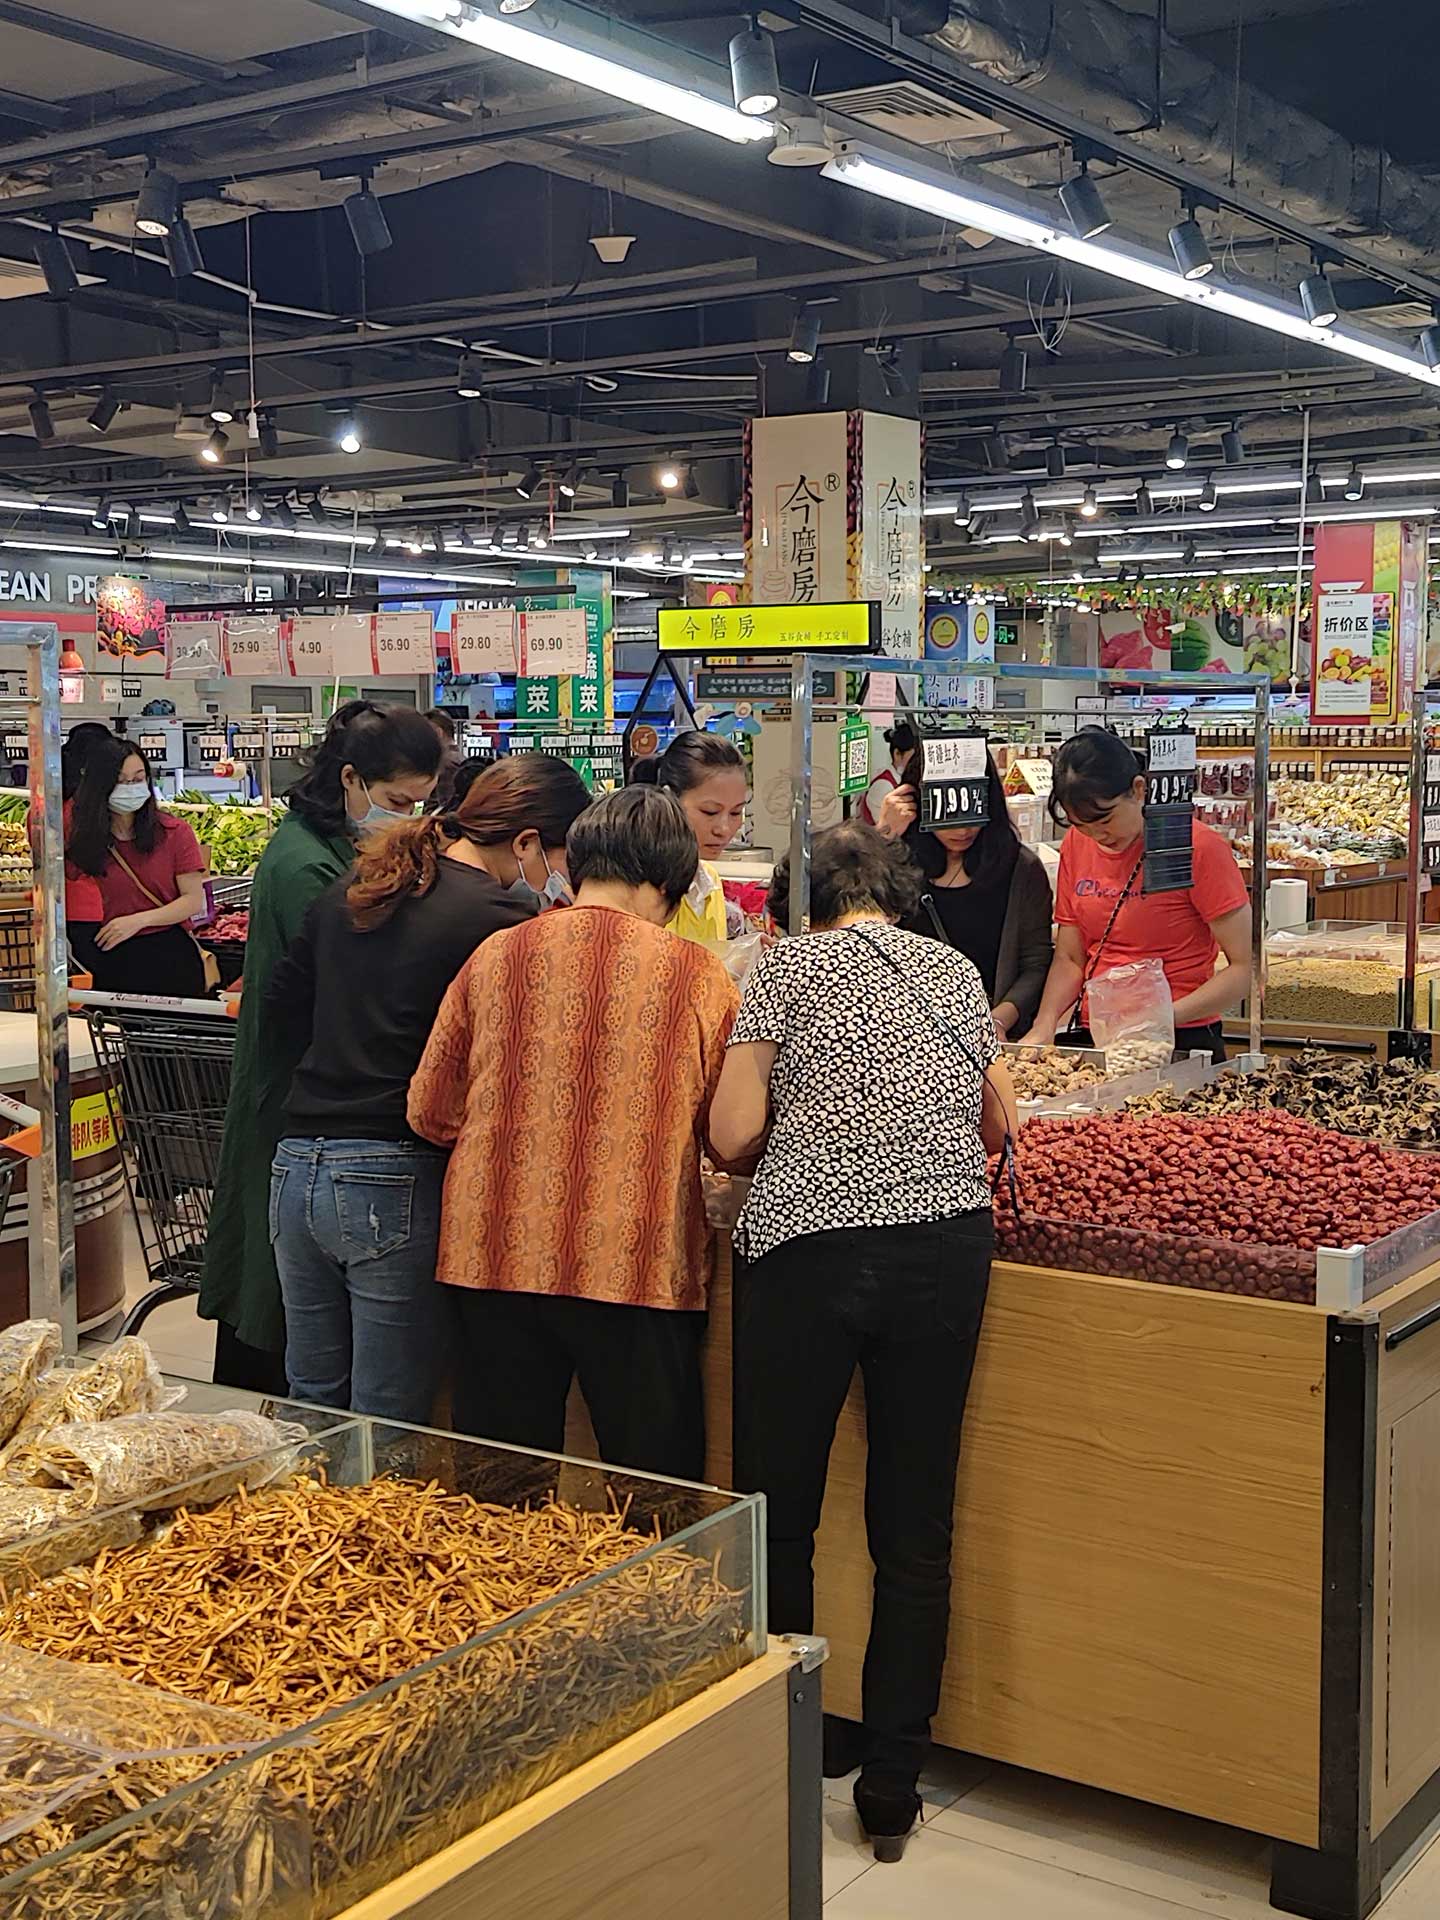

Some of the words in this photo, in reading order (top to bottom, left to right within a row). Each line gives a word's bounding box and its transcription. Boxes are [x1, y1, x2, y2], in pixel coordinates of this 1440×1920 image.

[780, 474, 825, 603] 今磨房
[680, 613, 756, 641] 今磨房
[1324, 616, 1369, 633] 折价区
[232, 640, 260, 654] 25.90
[299, 641, 322, 654] 4.90
[380, 638, 410, 651] 36.90
[460, 636, 491, 650] 29.80
[530, 637, 563, 651] 69.90
[932, 786, 970, 820] 7.98
